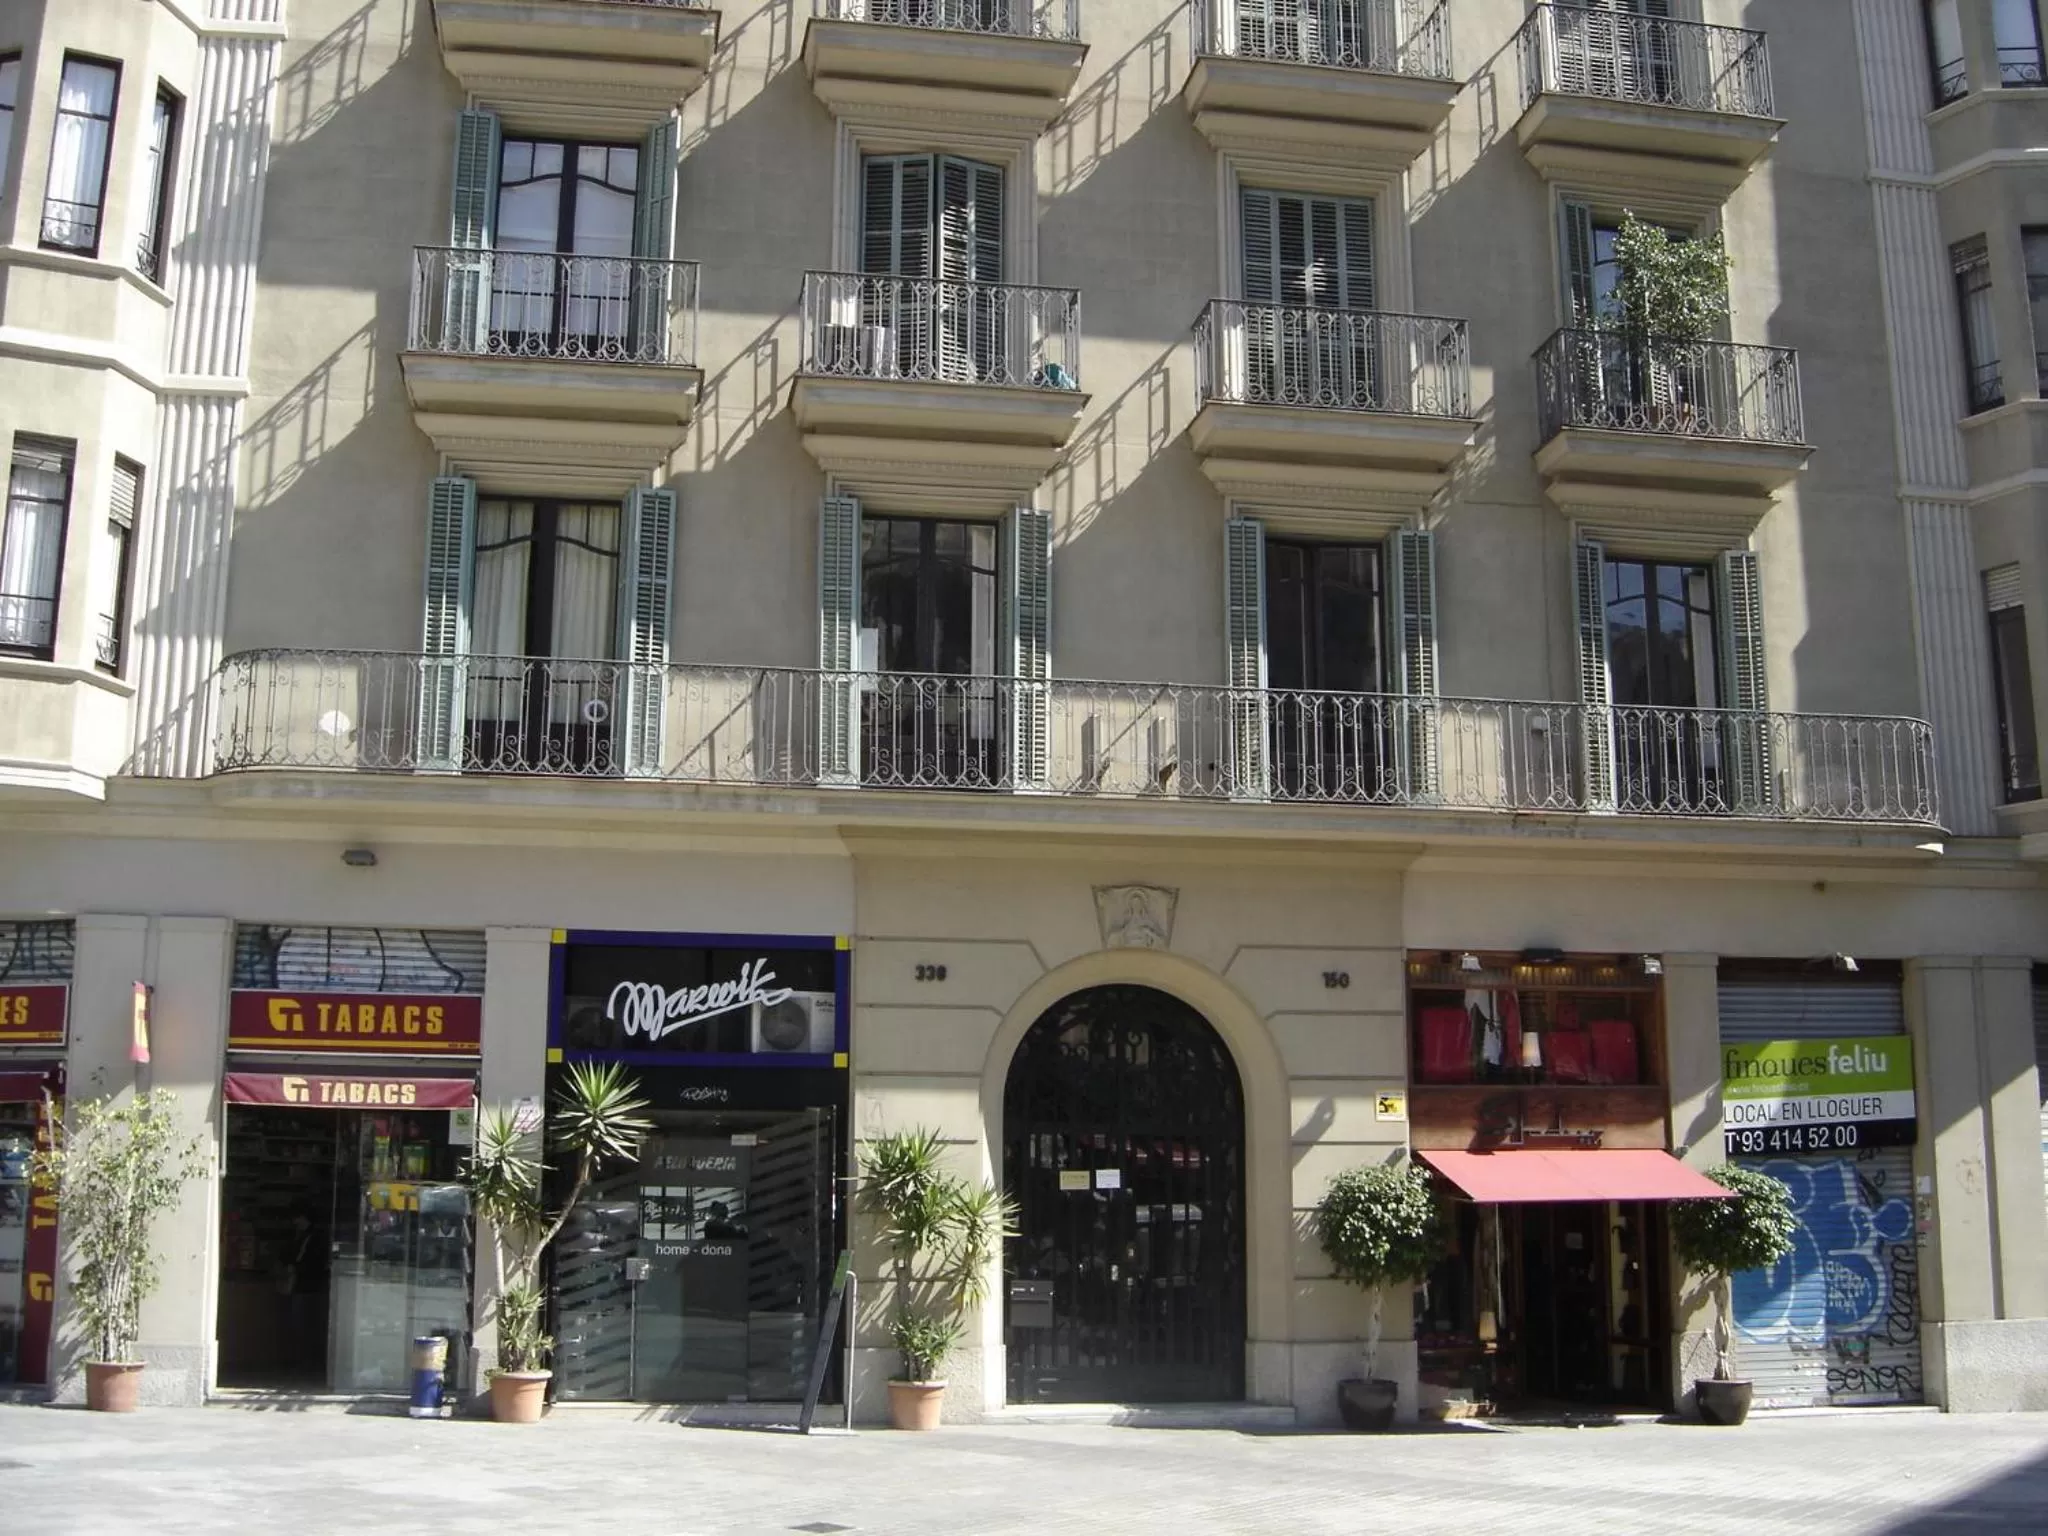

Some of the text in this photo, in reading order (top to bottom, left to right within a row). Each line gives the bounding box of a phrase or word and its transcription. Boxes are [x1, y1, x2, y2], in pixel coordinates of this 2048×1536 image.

[1321, 971, 1350, 989] 150
[317, 1003, 444, 1035] TABACS
[319, 1081, 416, 1105] TABACS
[1724, 1097, 1883, 1124] LOCAL EN LLOGUER
[1770, 1128, 1802, 1151] 414
[1808, 1126, 1830, 1149] 52
[1835, 1125, 1857, 1148] 00
[655, 1243, 690, 1256] home
[701, 1243, 732, 1256] dona
